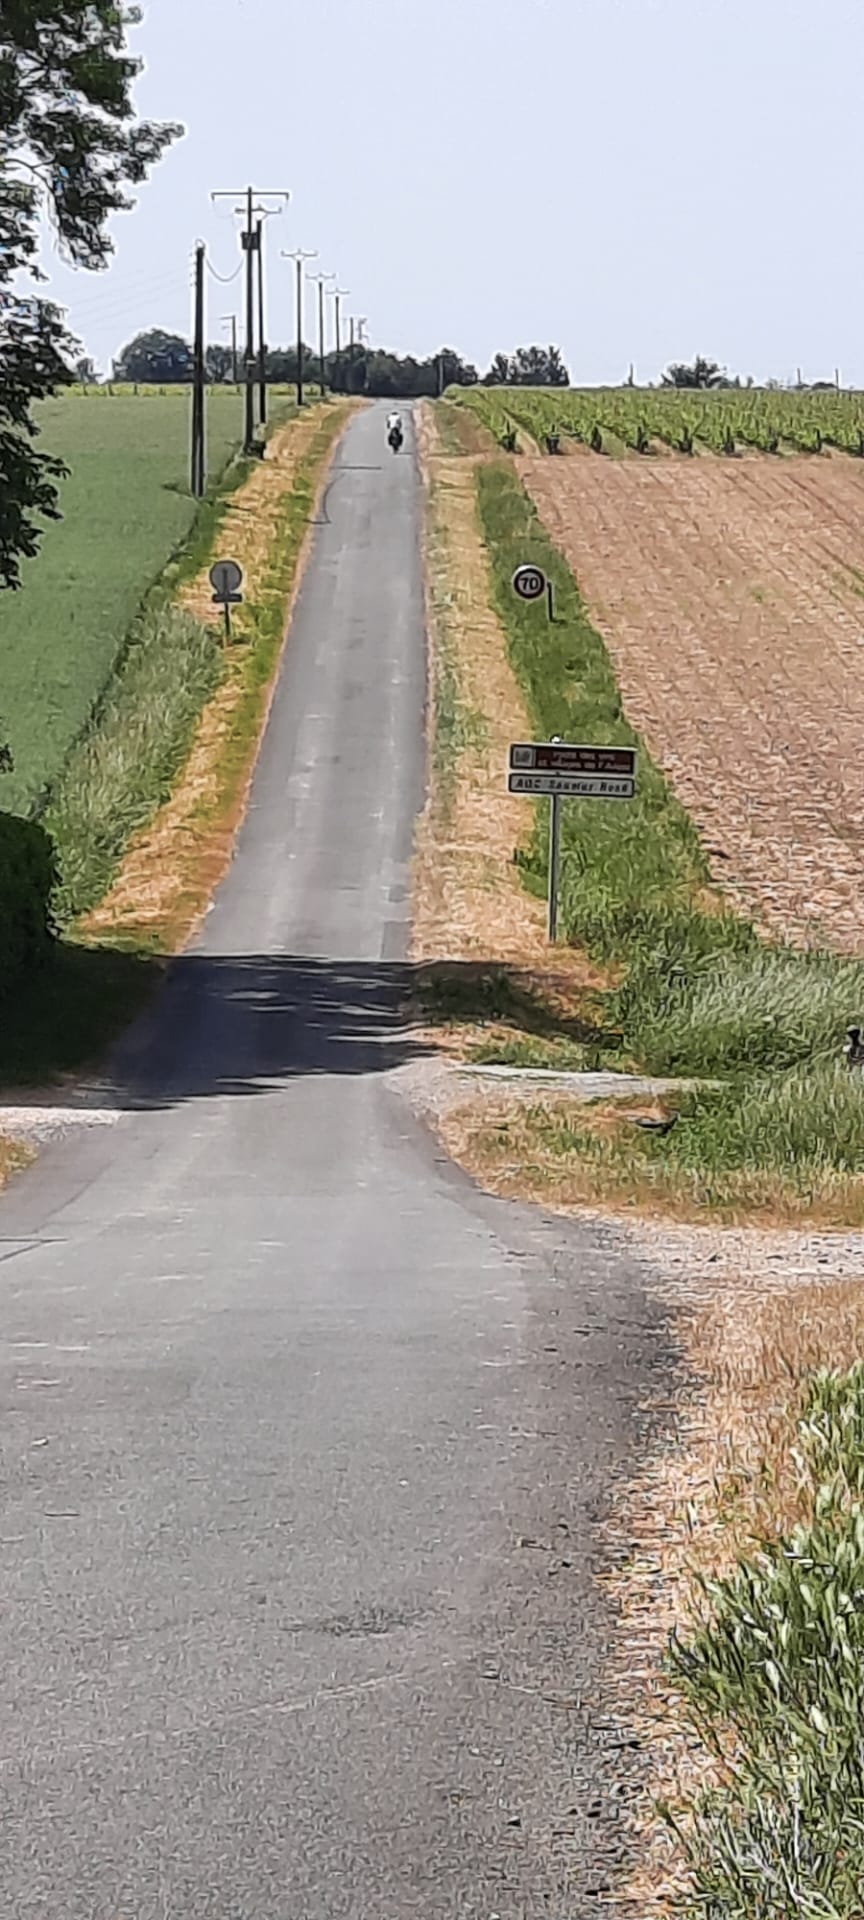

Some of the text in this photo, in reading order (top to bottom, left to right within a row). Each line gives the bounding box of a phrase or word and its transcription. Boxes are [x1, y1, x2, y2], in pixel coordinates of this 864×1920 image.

[520, 577, 539, 590] 70
[516, 778, 542, 789] AOC
[549, 779, 594, 792] Saumur
